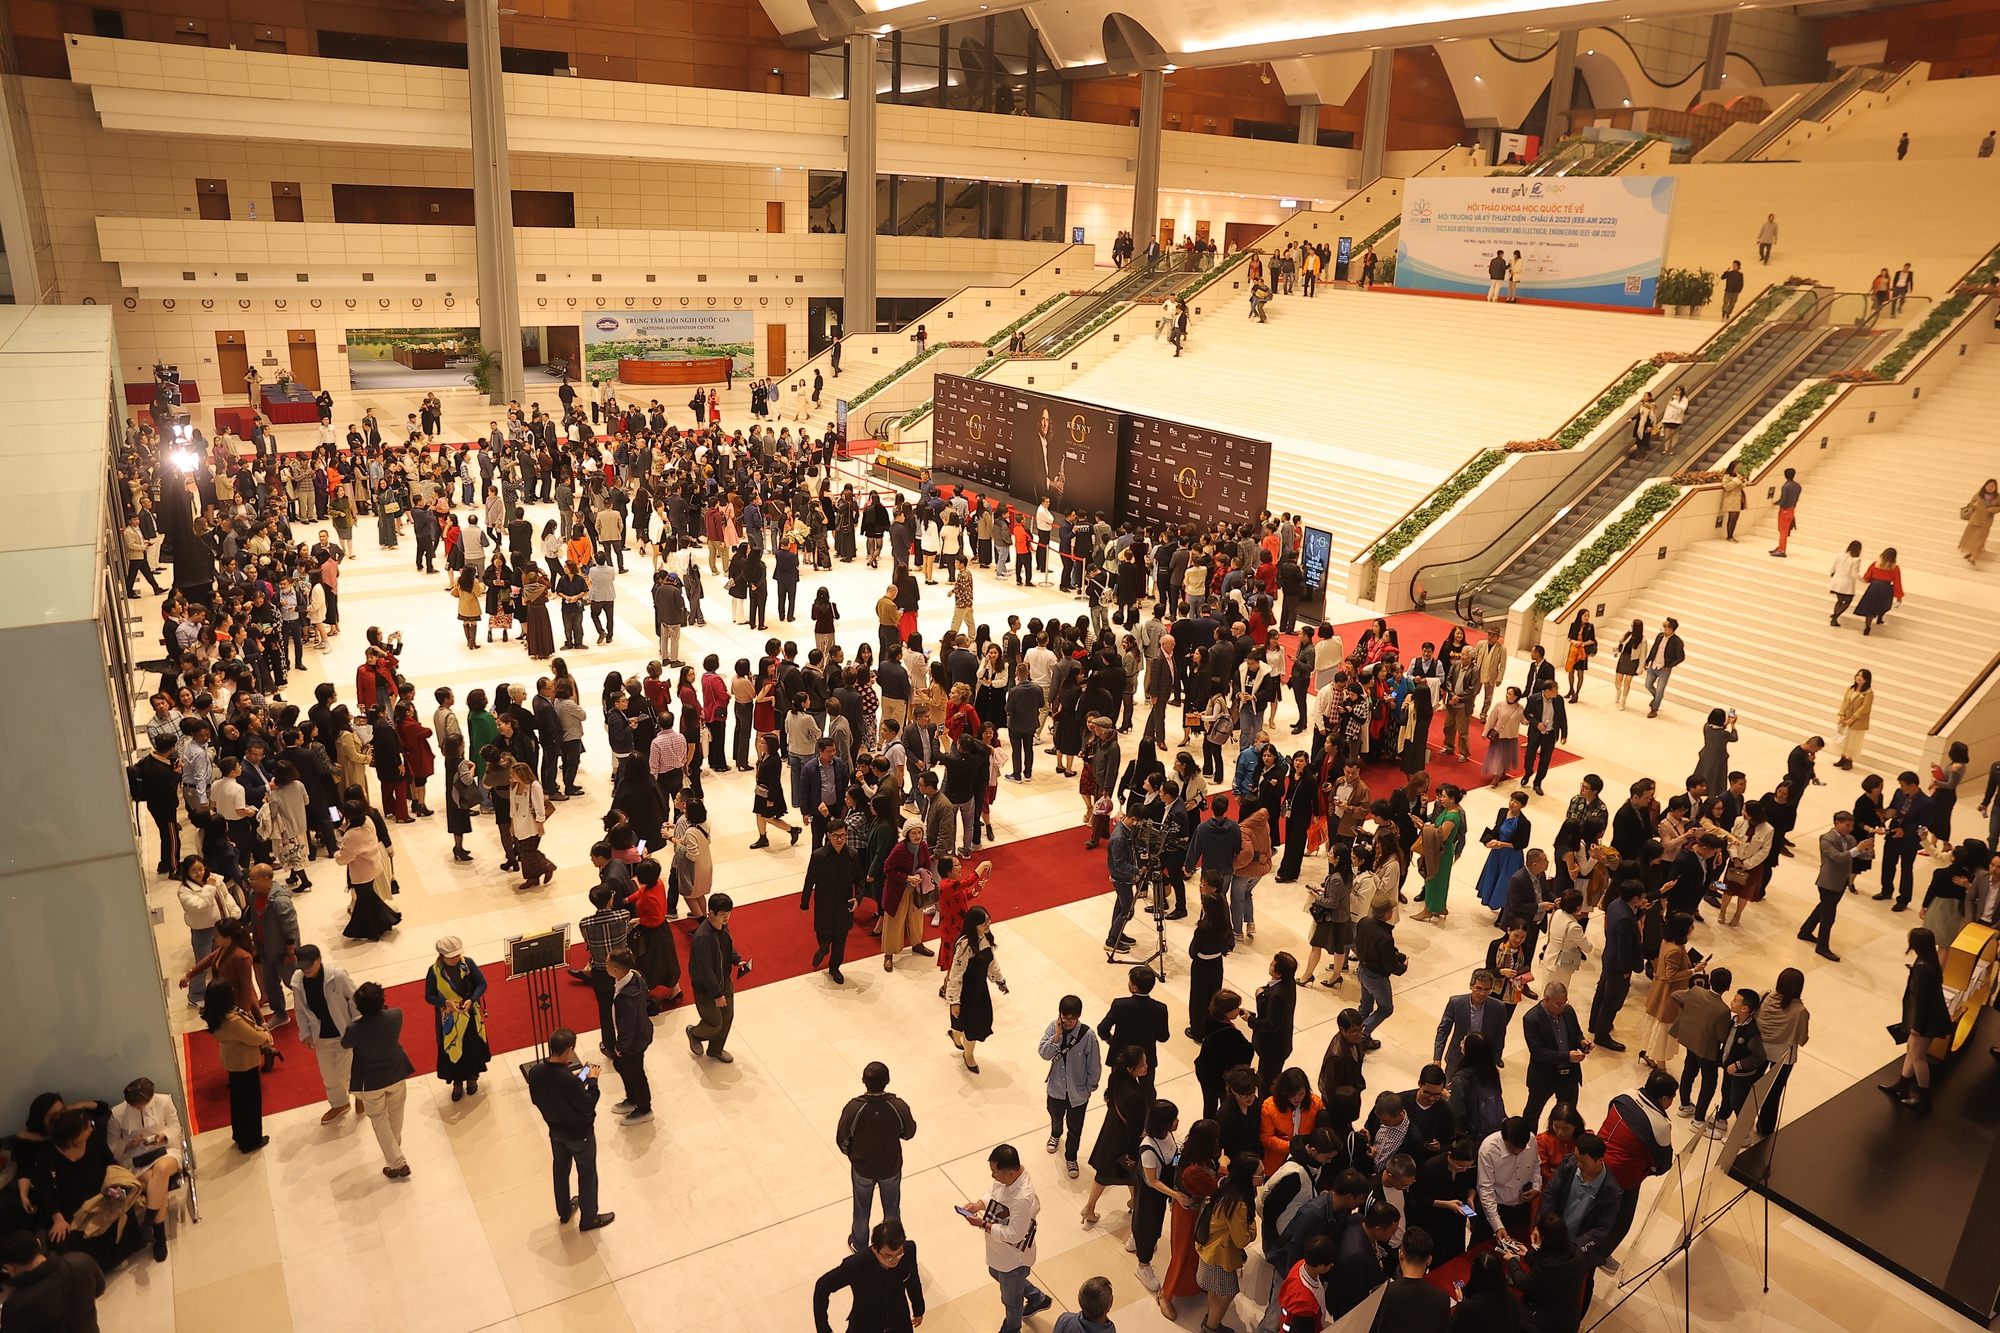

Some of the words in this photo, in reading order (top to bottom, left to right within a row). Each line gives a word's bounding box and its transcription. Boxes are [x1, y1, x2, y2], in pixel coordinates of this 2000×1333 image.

[1468, 203, 1479, 213] HỘI
[1481, 202, 1500, 212] THẢO
[1523, 205, 1539, 214] HỌC
[1540, 203, 1562, 213] QUỐC
[1564, 203, 1573, 213] TẾ
[1575, 204, 1585, 213] VỀ
[1599, 217, 1618, 225] 2023)
[966, 420, 987, 432] KENNY
[1067, 421, 1092, 434] KENNY
[1173, 473, 1204, 489] KENNY
[1178, 467, 1197, 499] G
